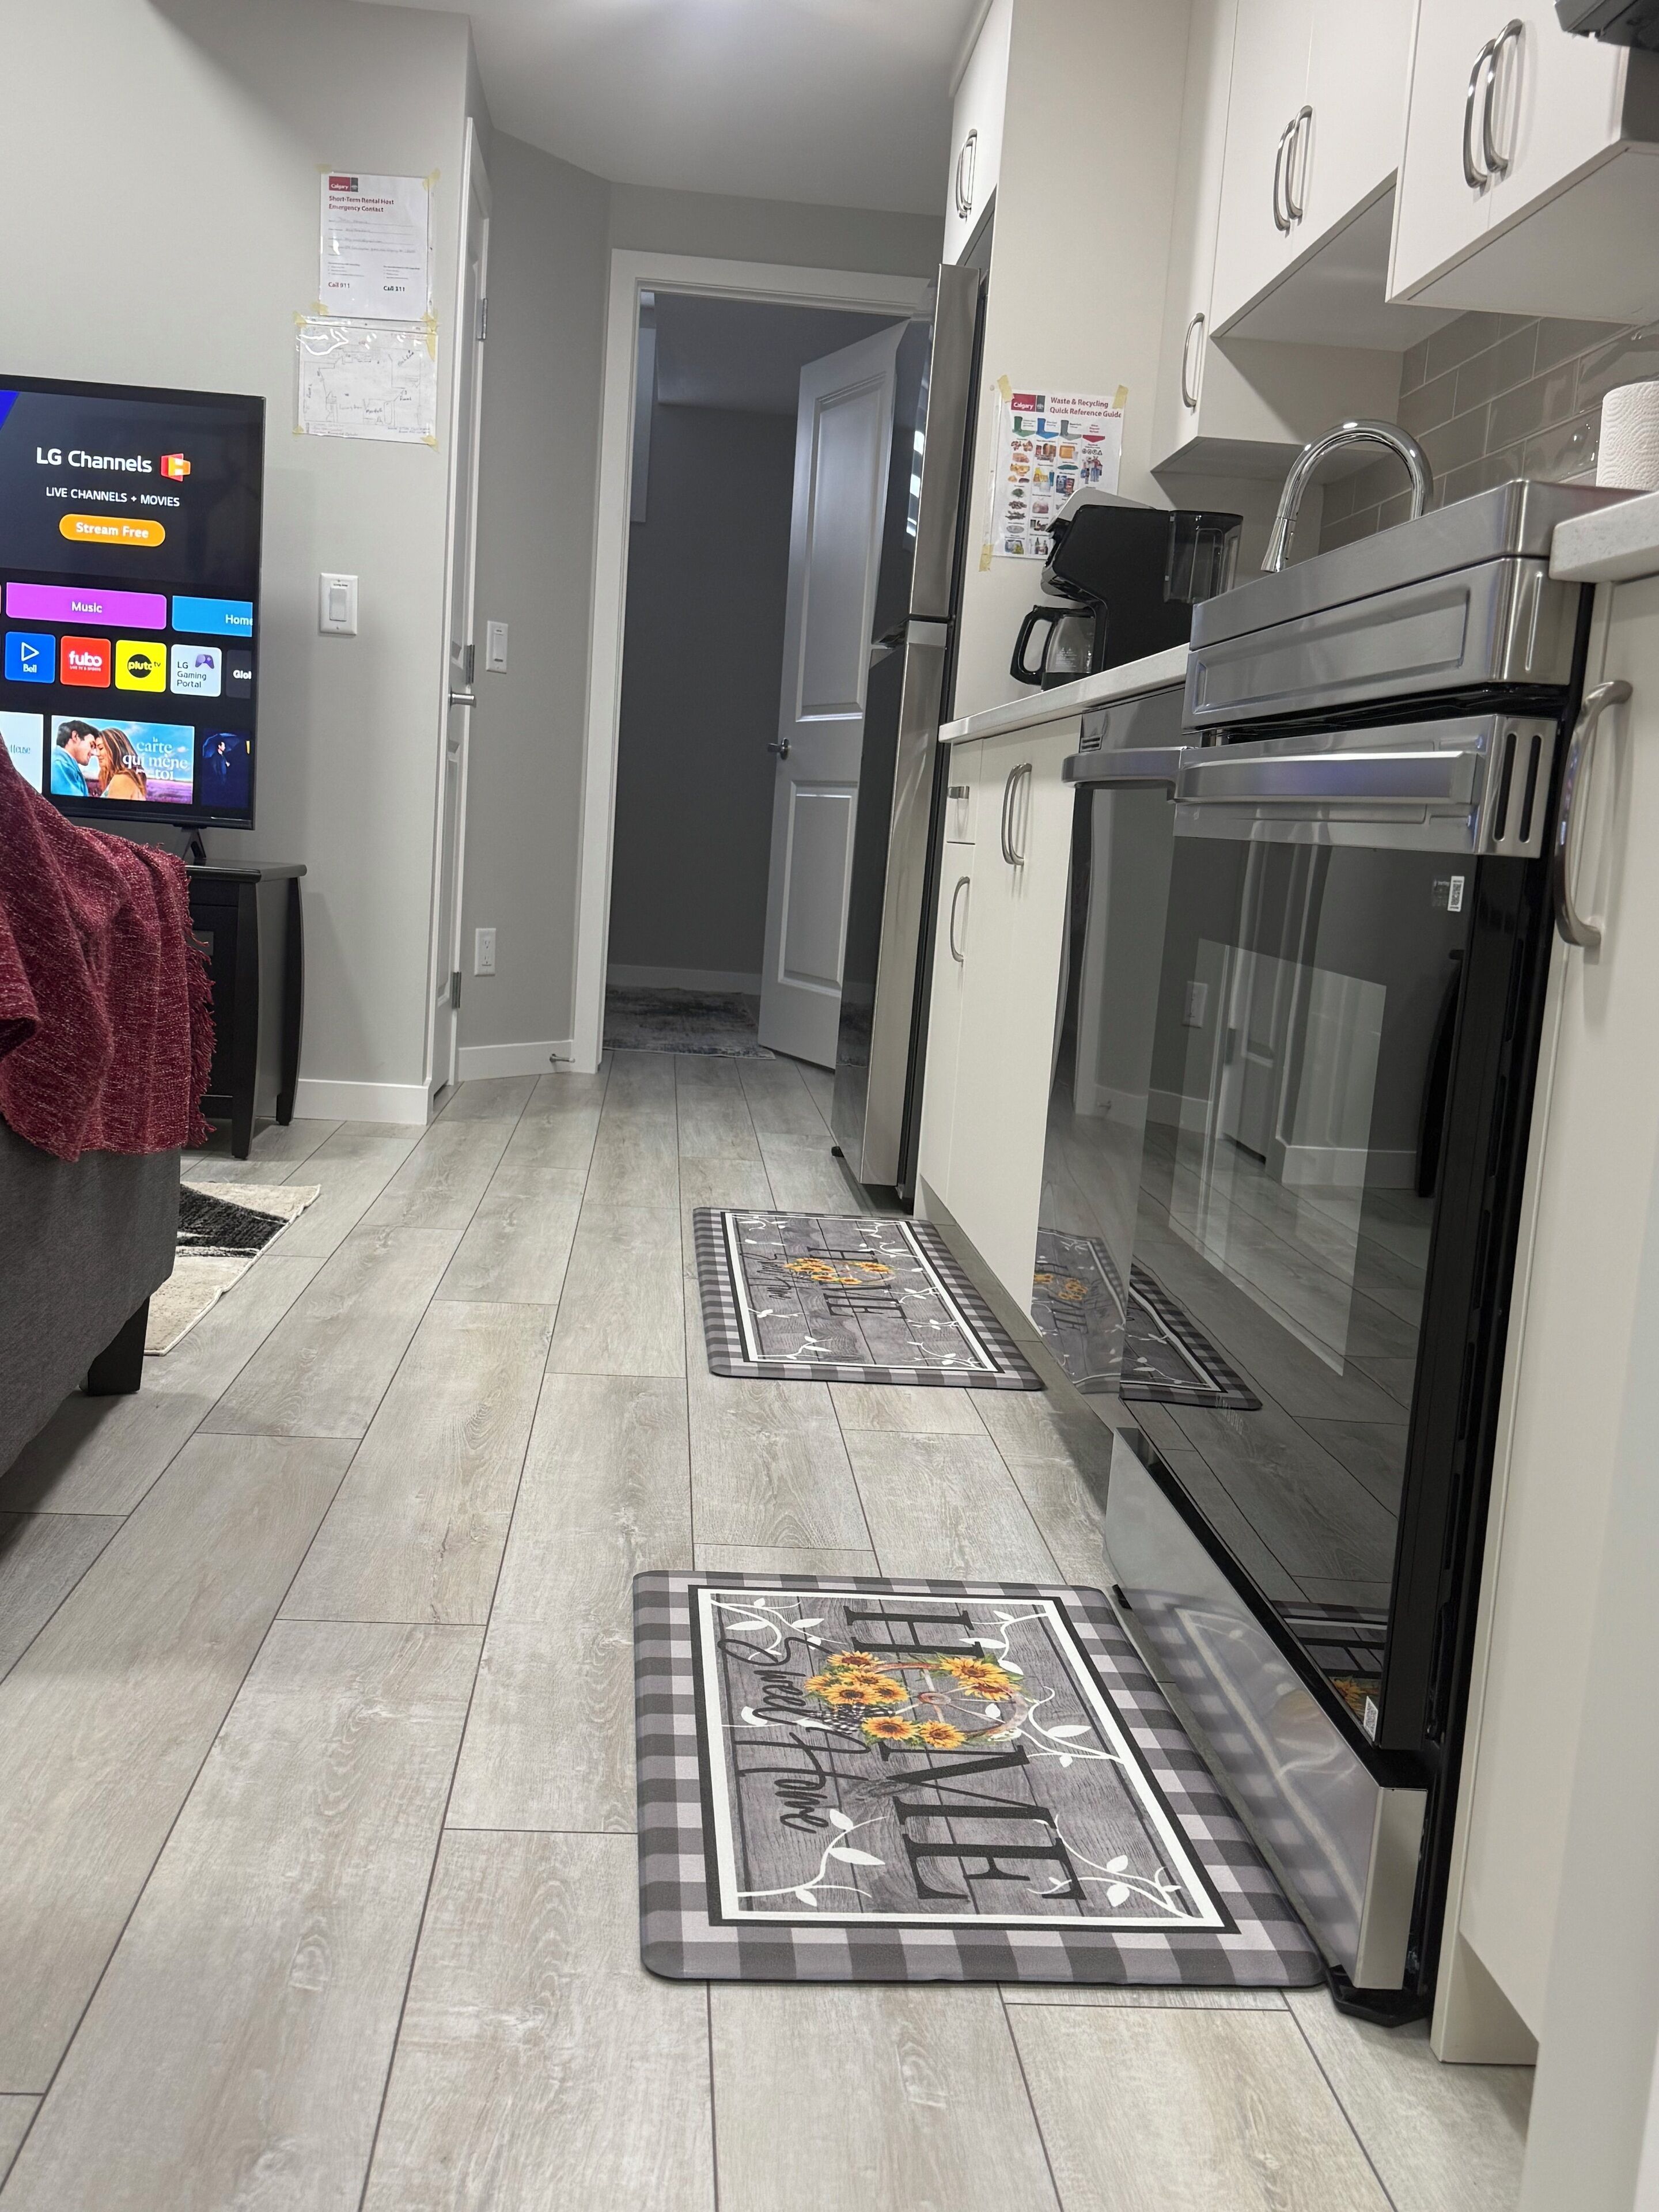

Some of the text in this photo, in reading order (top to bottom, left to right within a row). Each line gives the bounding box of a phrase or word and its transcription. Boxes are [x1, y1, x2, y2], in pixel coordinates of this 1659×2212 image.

[329, 203, 361, 211] Emergency
[1013, 402, 1033, 410] Calgary
[1051, 397, 1070, 405] Waste
[1078, 399, 1108, 408] Recycling
[1070, 408, 1102, 416] Reference
[36, 446, 152, 473] LG Channels
[46, 487, 67, 498] LIVE
[71, 488, 127, 502] CHANNELS
[141, 494, 180, 507] MOVIES
[76, 522, 149, 539] Stream Free
[71, 601, 103, 614] Music
[69, 650, 103, 667] fubo
[23, 663, 37, 673] Bell
[128, 661, 153, 671] pluto
[177, 671, 207, 681] Gaming
[177, 680, 202, 688] Portal
[137, 741, 172, 754] carte
[122, 753, 188, 770] qui mène
[155, 768, 174, 780] toi
[733, 1728, 871, 1834] Home
